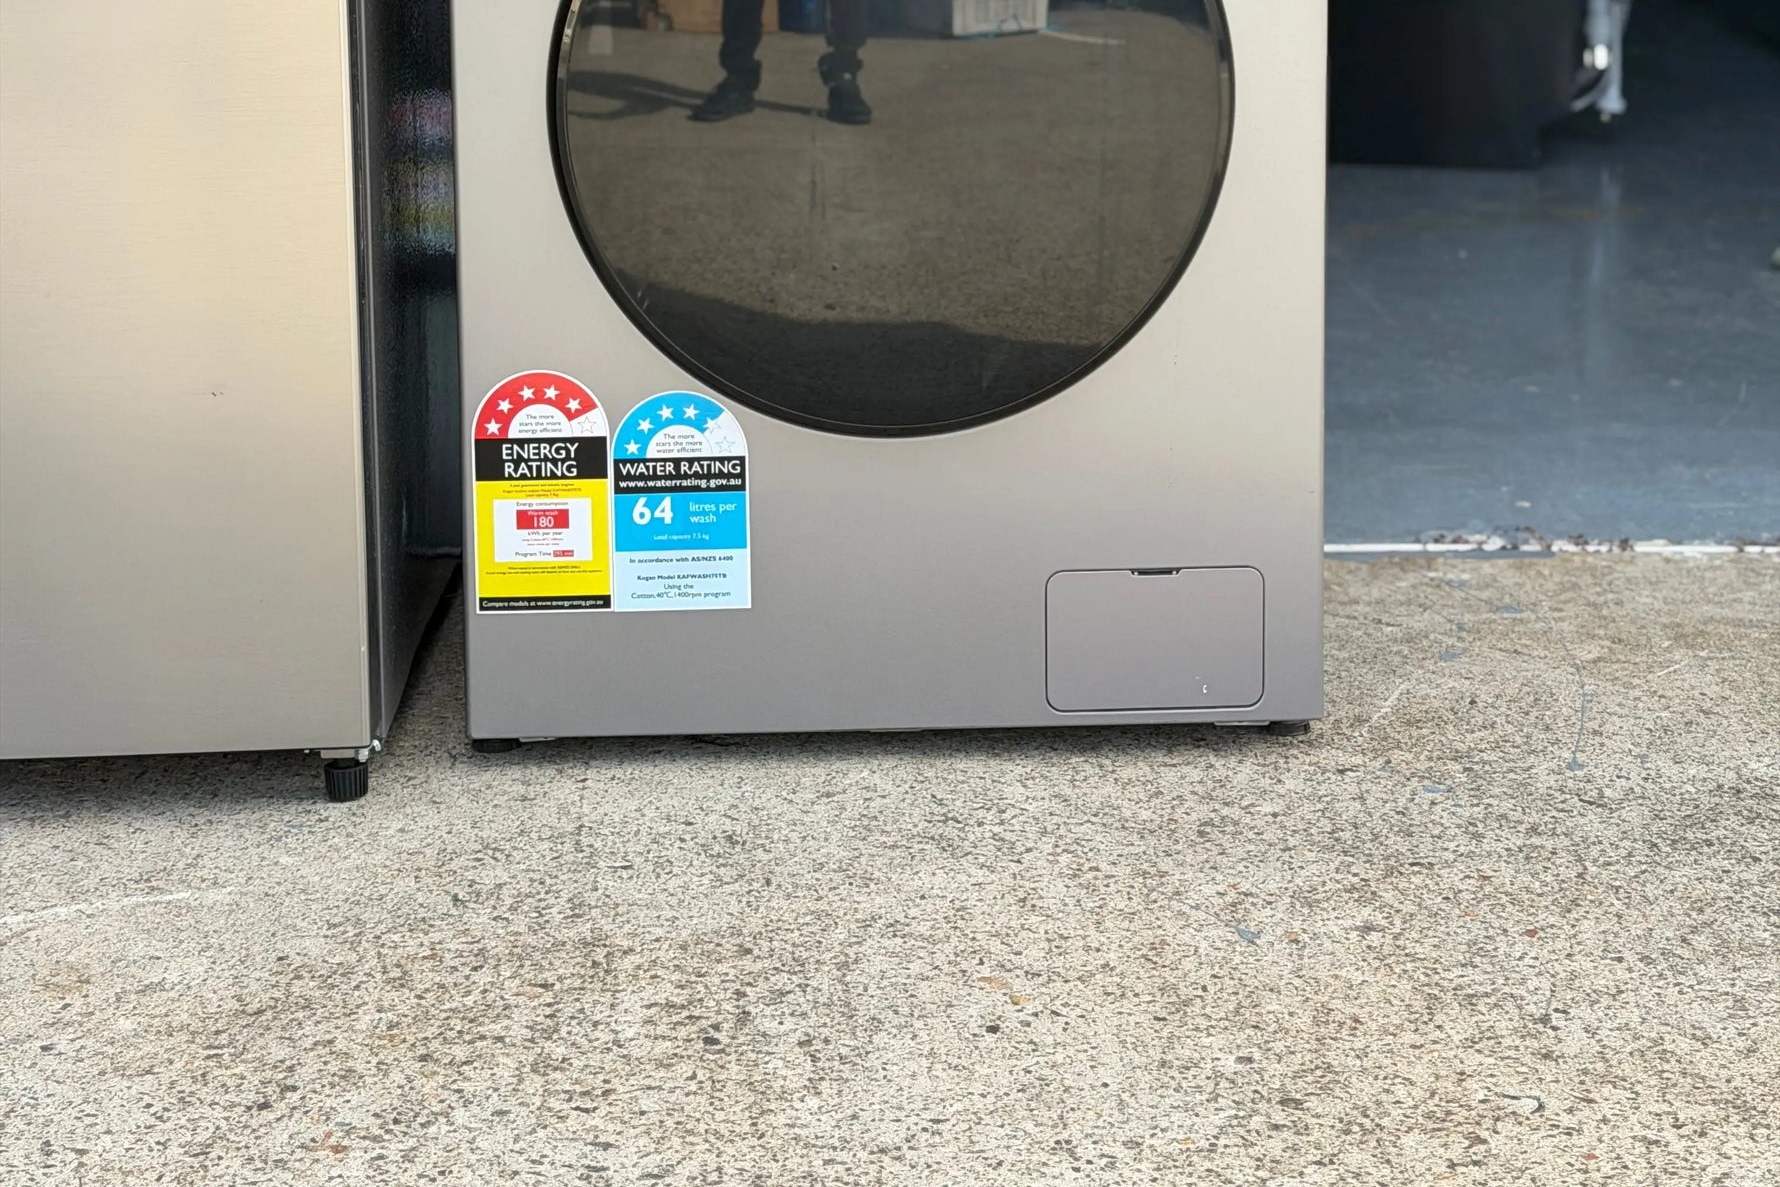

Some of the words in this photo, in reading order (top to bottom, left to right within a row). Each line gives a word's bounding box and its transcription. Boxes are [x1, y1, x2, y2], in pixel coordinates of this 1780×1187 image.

[502, 442, 580, 460] ENERGY
[504, 460, 578, 478] RATING
[619, 461, 676, 476] WATER
[680, 460, 741, 475] RATING
[618, 477, 742, 488] www.waterrating.gov.au
[632, 496, 674, 525] 64
[689, 502, 716, 512] litres
[719, 502, 737, 513] per
[533, 516, 555, 528] 180
[689, 514, 717, 523] wash
[482, 600, 509, 608] Compare
